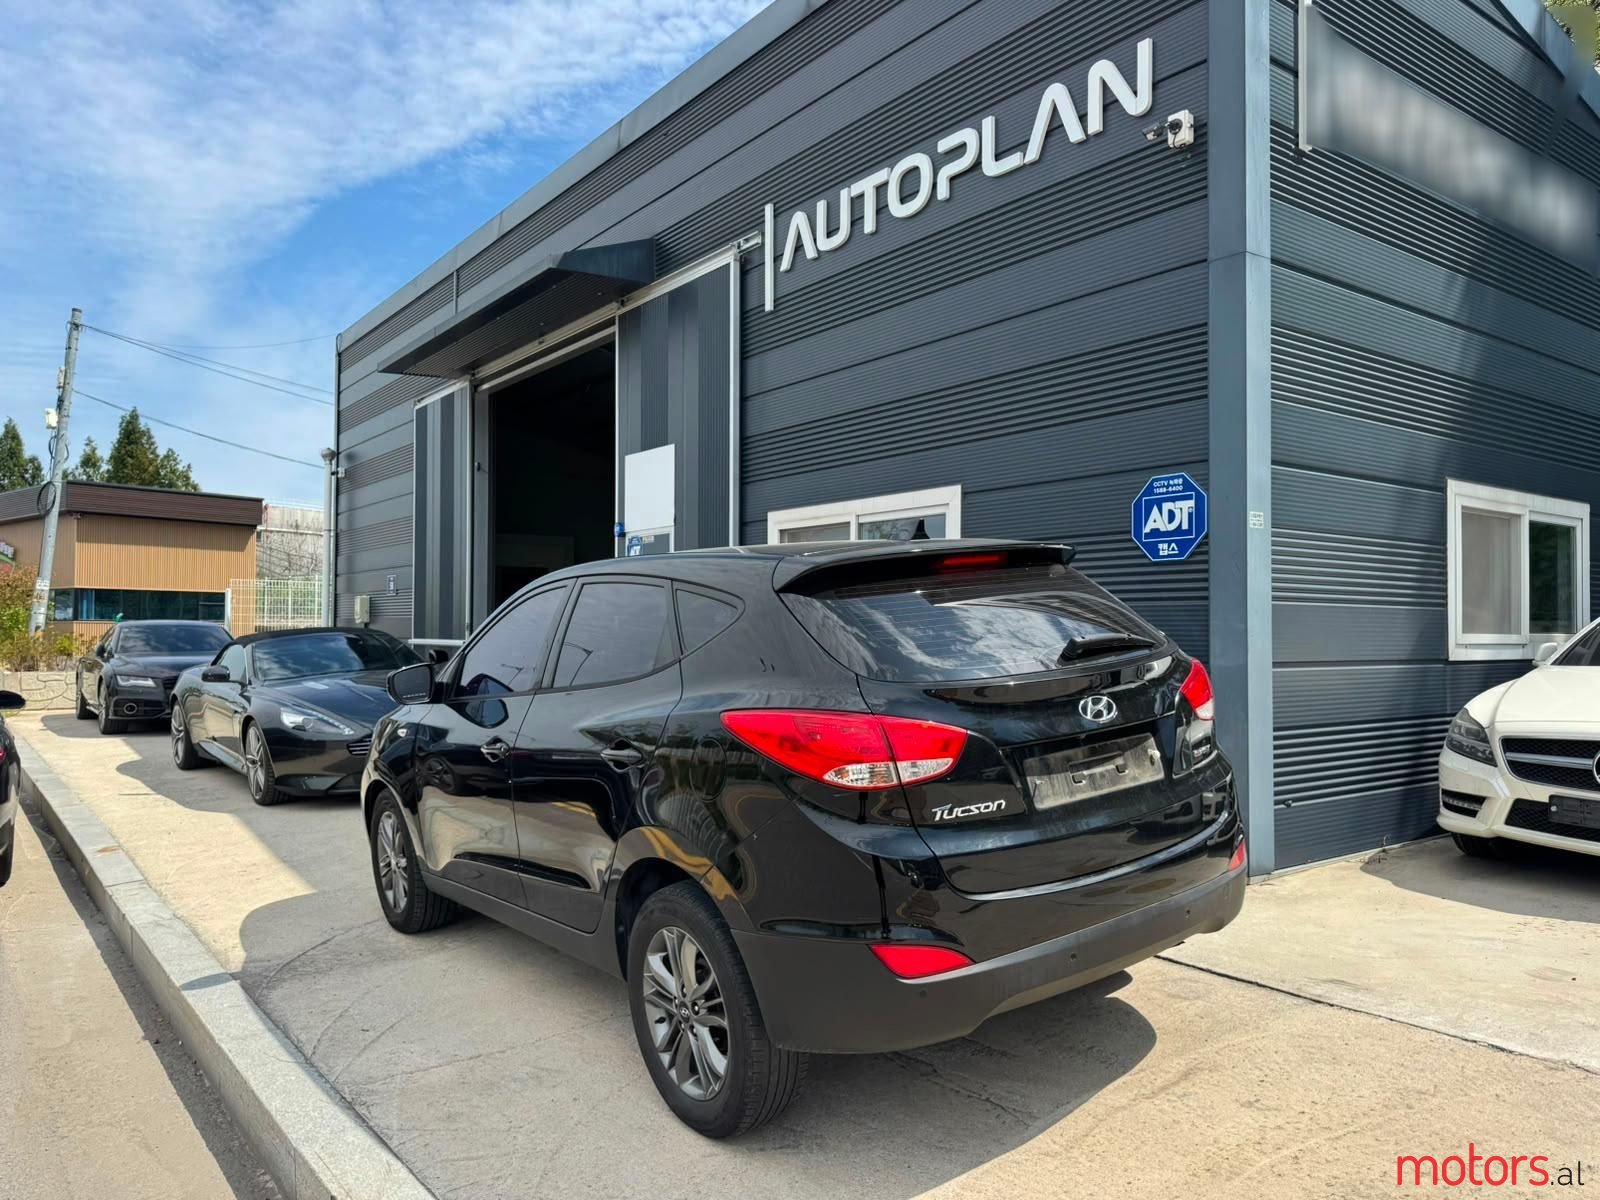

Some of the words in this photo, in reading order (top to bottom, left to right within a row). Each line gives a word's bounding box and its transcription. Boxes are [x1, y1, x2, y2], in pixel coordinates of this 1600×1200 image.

[780, 37, 1153, 272] AUTOPLAN
[1153, 480, 1168, 488] CCTV
[1144, 500, 1195, 533] ADT
